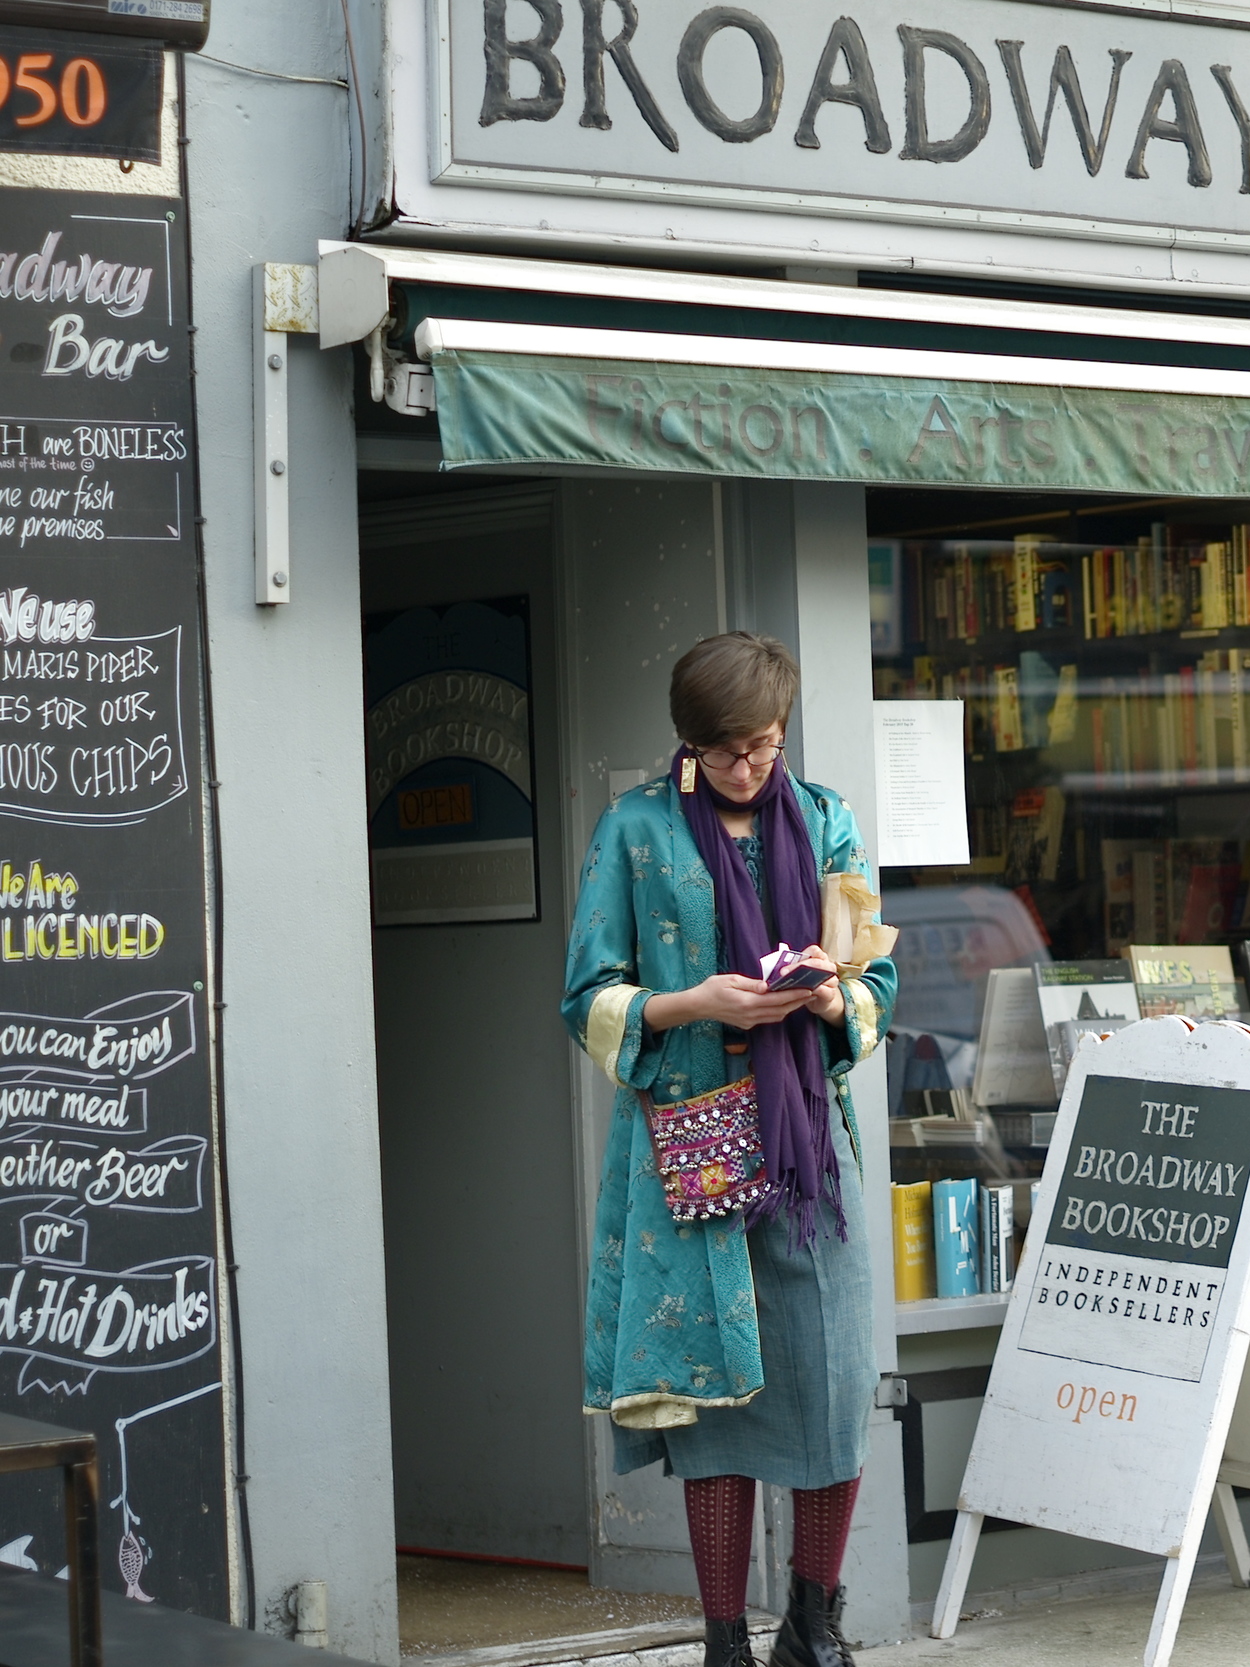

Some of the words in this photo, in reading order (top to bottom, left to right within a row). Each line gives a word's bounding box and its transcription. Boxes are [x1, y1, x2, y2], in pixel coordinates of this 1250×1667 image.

[44, 313, 170, 382] Bar
[43, 435, 74, 456] are
[73, 426, 187, 461] BONELESS
[585, 376, 827, 459] Fiction
[907, 395, 1056, 470] Arts
[19, 457, 28, 472] of
[29, 457, 47, 469] the
[49, 457, 77, 470] time
[30, 487, 70, 510] our
[73, 475, 115, 517] fish
[20, 515, 105, 548] premises
[39, 599, 94, 643] use
[2, 650, 80, 682] MARIS
[86, 645, 160, 683] PIPER
[37, 696, 88, 730] FOR
[101, 691, 156, 726] OUR
[372, 673, 528, 740] BROADWAY
[70, 734, 172, 798] CHIPS
[372, 720, 522, 797] BOOKSHOP
[402, 786, 468, 825] OPEN
[26, 860, 79, 910] Are
[3, 913, 164, 962] LICENCED
[1137, 959, 1194, 985] WES
[39, 1028, 87, 1061] can
[88, 1016, 173, 1076] Enjoy
[61, 1084, 130, 1128] meal
[1140, 1101, 1200, 1139] THE
[0, 1139, 92, 1189] either
[85, 1147, 189, 1206] Beer
[1073, 1145, 1244, 1198] BROADWAY
[34, 1223, 73, 1254] or
[1060, 1196, 1231, 1249] BOOKSHOP
[1043, 1261, 1218, 1302] INDEPENDENT
[27, 1276, 97, 1349] Hot
[83, 1267, 209, 1358] Drinks
[1038, 1287, 1210, 1328] BOOKSELLERS
[1056, 1381, 1138, 1425] open
